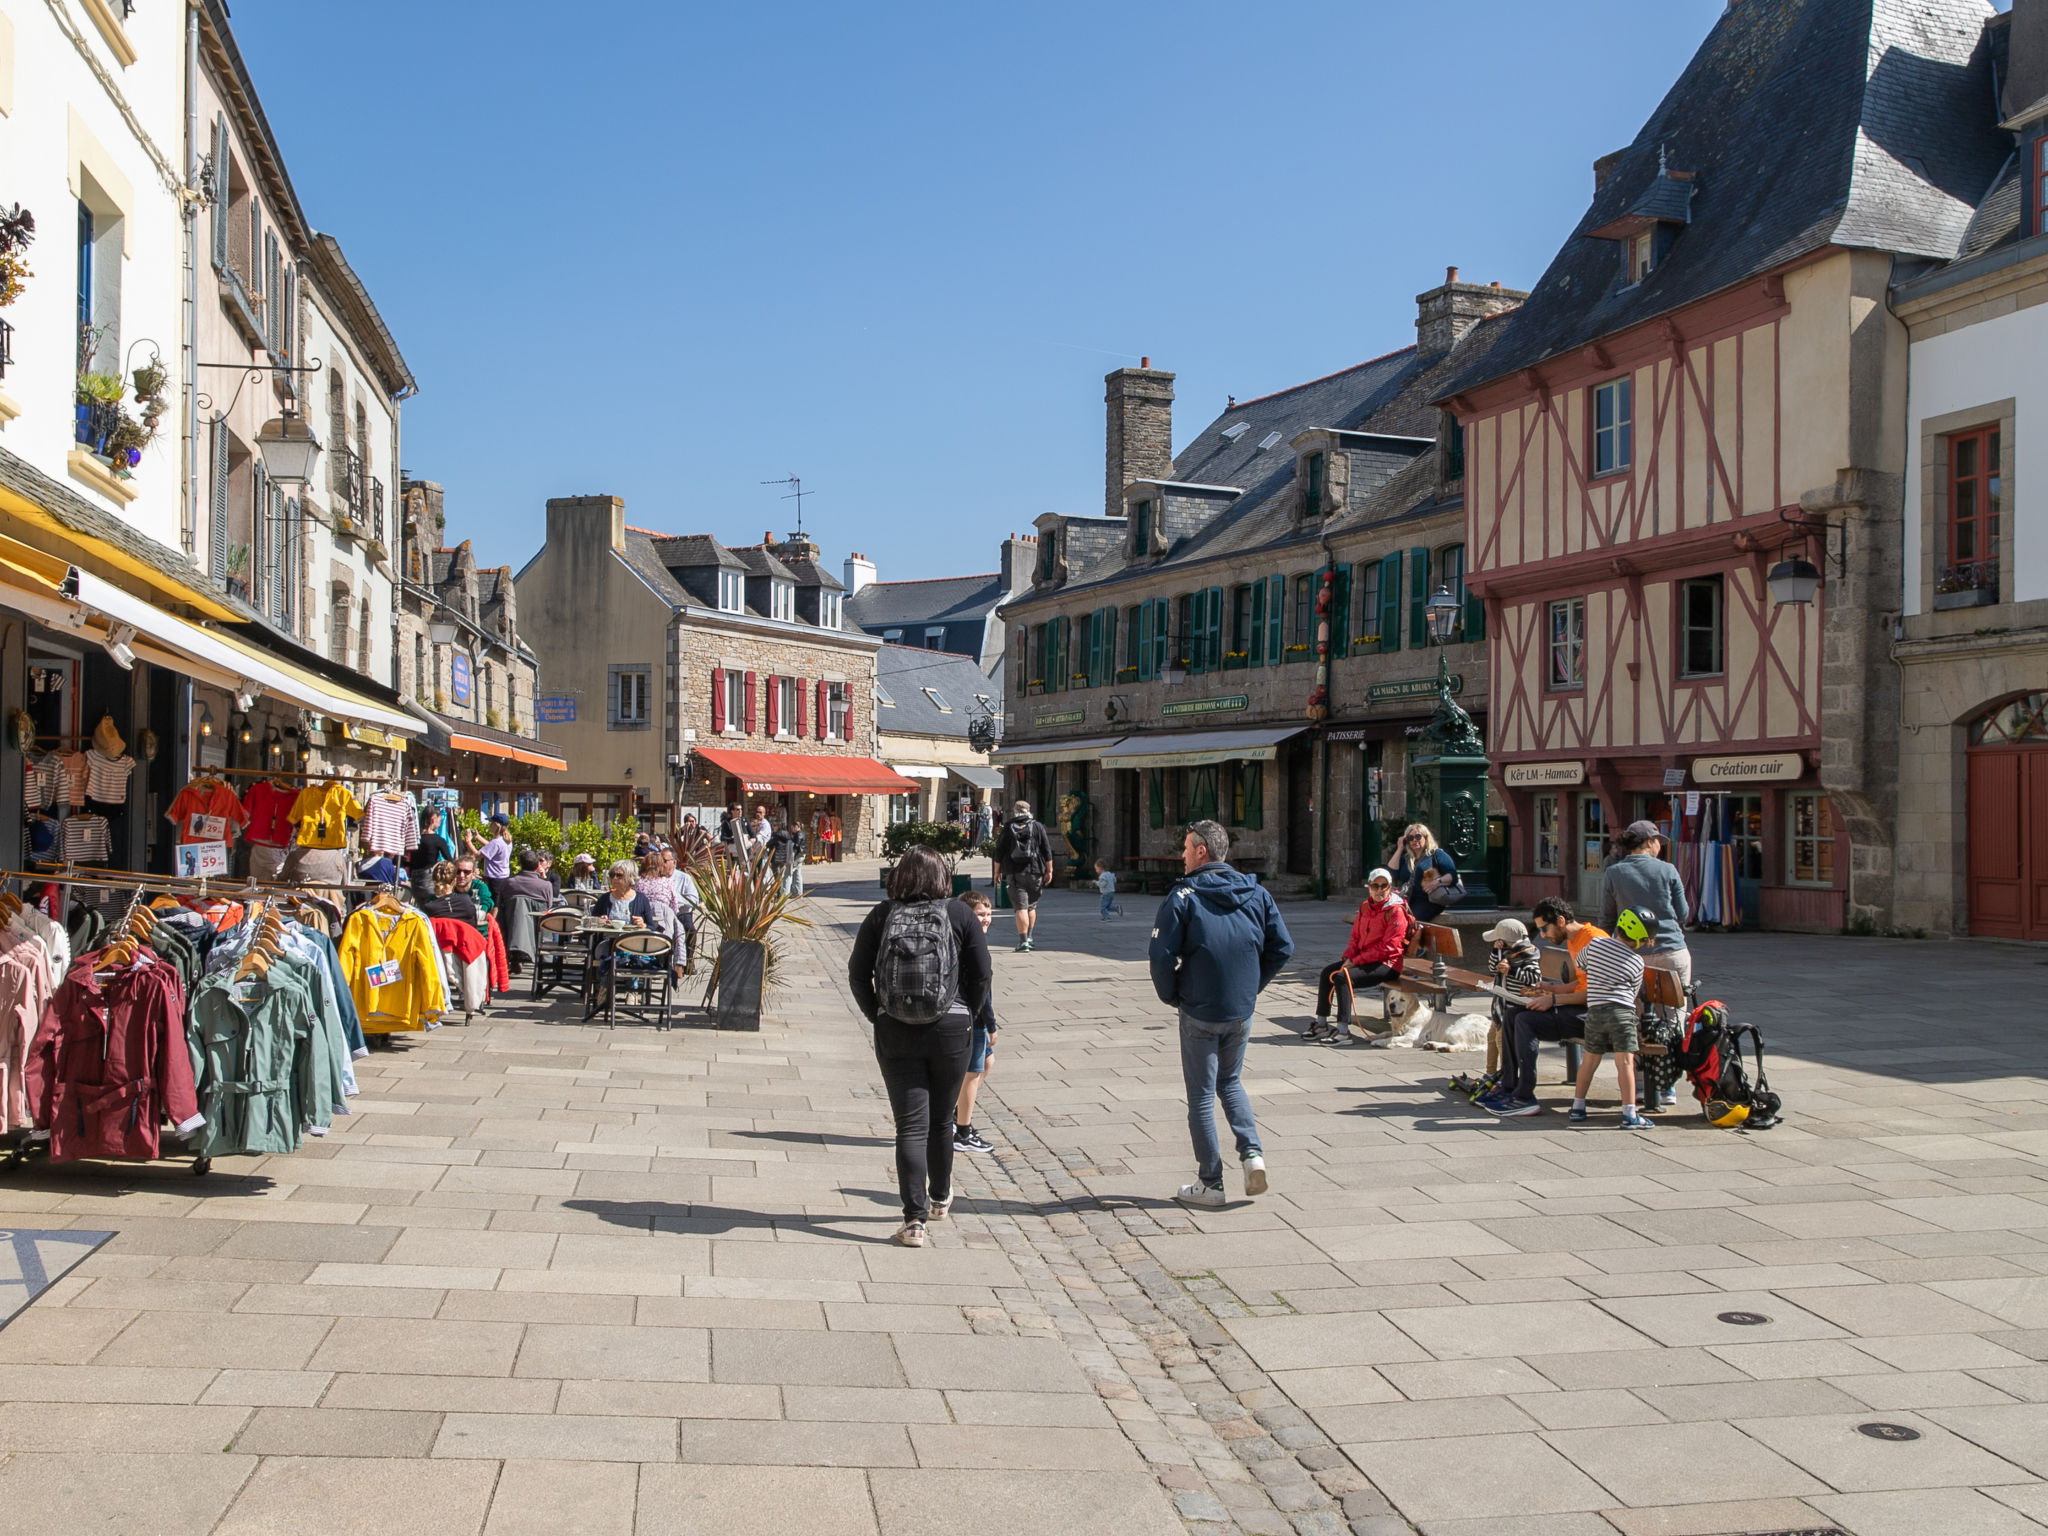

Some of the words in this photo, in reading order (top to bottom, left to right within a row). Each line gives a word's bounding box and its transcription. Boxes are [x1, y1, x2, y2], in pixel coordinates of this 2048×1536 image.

[1327, 730, 1365, 741] PATISSERIE
[1710, 761, 1757, 776] Création
[1760, 760, 1783, 774] cuir
[1510, 768, 1525, 781] Kêr
[1526, 769, 1539, 780] LM
[1544, 768, 1578, 780] Hamacs
[207, 825, 217, 833] 29
[202, 857, 217, 868] 59
